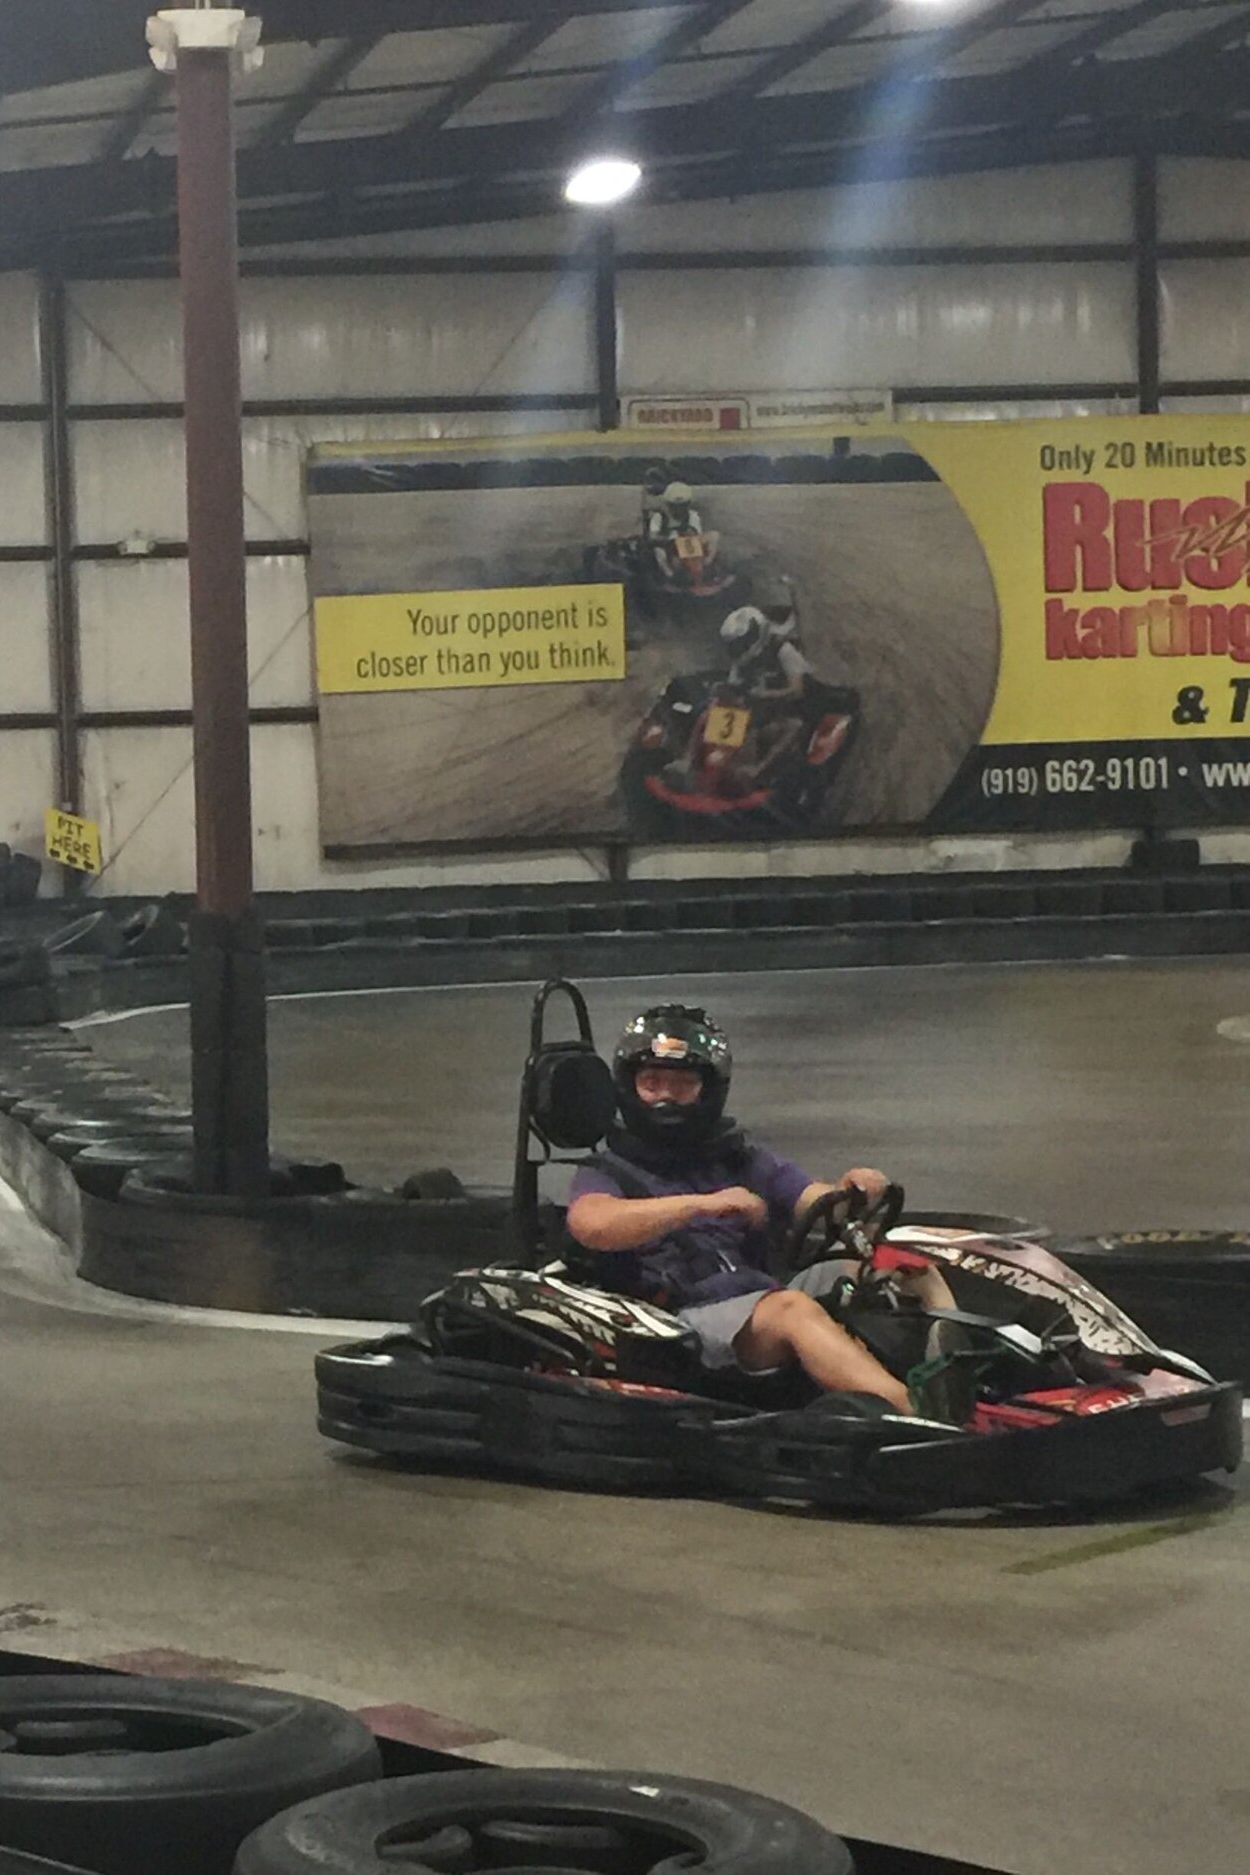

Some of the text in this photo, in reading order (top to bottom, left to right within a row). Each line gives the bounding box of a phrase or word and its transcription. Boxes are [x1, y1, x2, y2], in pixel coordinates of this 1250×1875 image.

[1040, 441, 1248, 475] Only 20 Minutes
[1042, 480, 1250, 593] Rus
[407, 602, 608, 639] Your opponent is
[356, 640, 616, 679] closer than you think.
[1172, 686, 1209, 725] &
[718, 711, 735, 740] 3
[981, 767, 1038, 798] (919)
[1045, 756, 1169, 793] 662-9101
[57, 815, 84, 837] PIT
[52, 836, 92, 861] HERE
